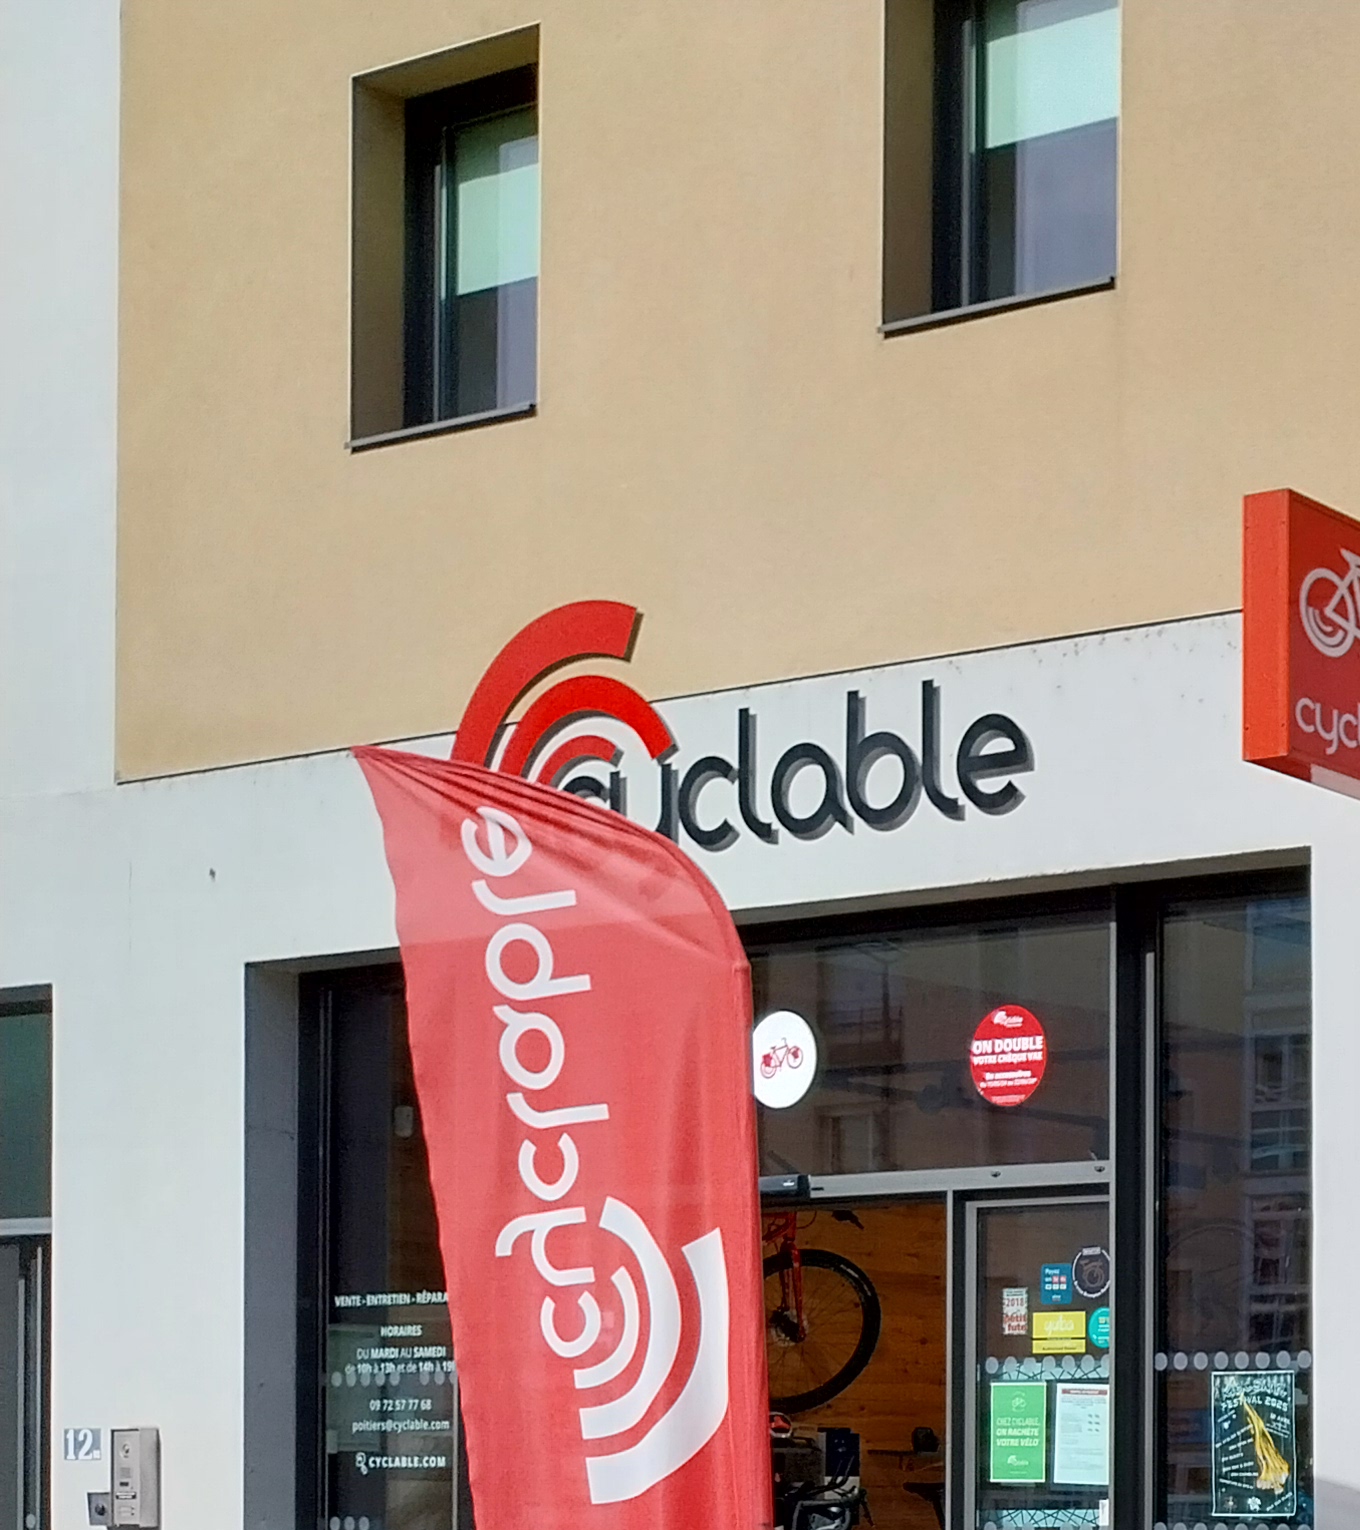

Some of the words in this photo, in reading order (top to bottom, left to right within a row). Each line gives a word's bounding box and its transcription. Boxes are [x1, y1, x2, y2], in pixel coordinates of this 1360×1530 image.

[972, 1040, 992, 1054] ON
[994, 1036, 1044, 1053] DOUBLE
[334, 1295, 361, 1307] VENTE
[366, 1292, 411, 1306] ENTRETIEN
[380, 1325, 422, 1337] HORAIRES
[356, 1348, 369, 1359] DU
[371, 1347, 399, 1359] MARDI
[400, 1347, 412, 1357] AU
[413, 1346, 446, 1358] SAMEDI
[383, 1400, 393, 1410] 72
[352, 1419, 450, 1434] poitiers@cyclable.com
[996, 1428, 1007, 1436] ON
[996, 1438, 1019, 1447] VOTRE
[1020, 1436, 1039, 1446] VÉLO
[368, 1456, 446, 1468] CYCLABLE.COM
